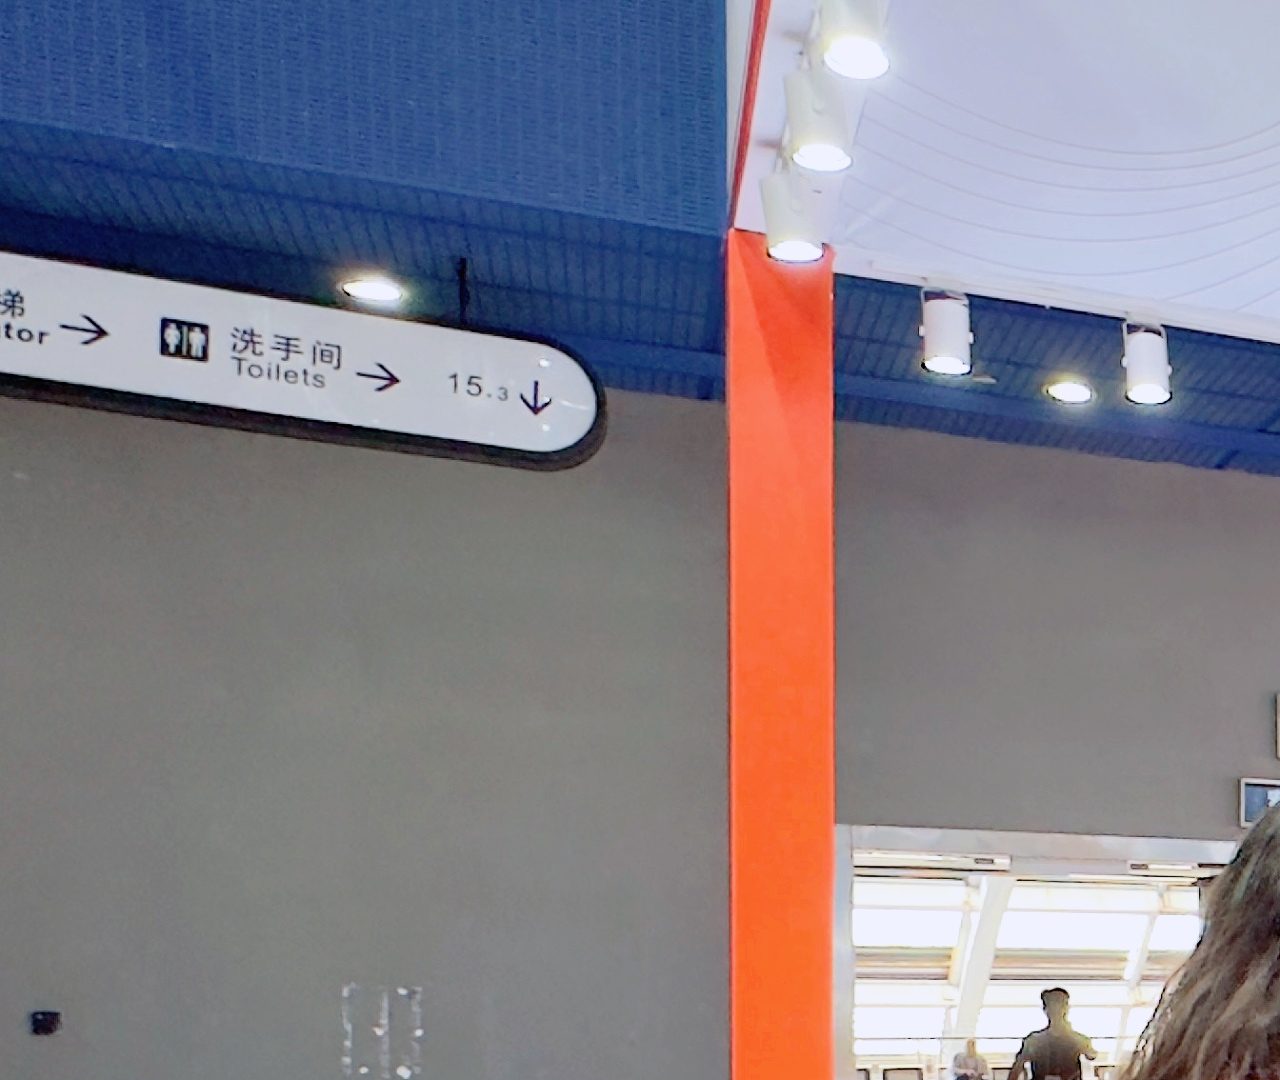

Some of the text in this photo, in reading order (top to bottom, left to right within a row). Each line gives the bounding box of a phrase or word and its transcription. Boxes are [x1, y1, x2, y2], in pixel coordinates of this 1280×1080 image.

[230, 326, 342, 371] 洗手间
[233, 357, 327, 389] Toilets
[447, 372, 509, 401] 15.3
